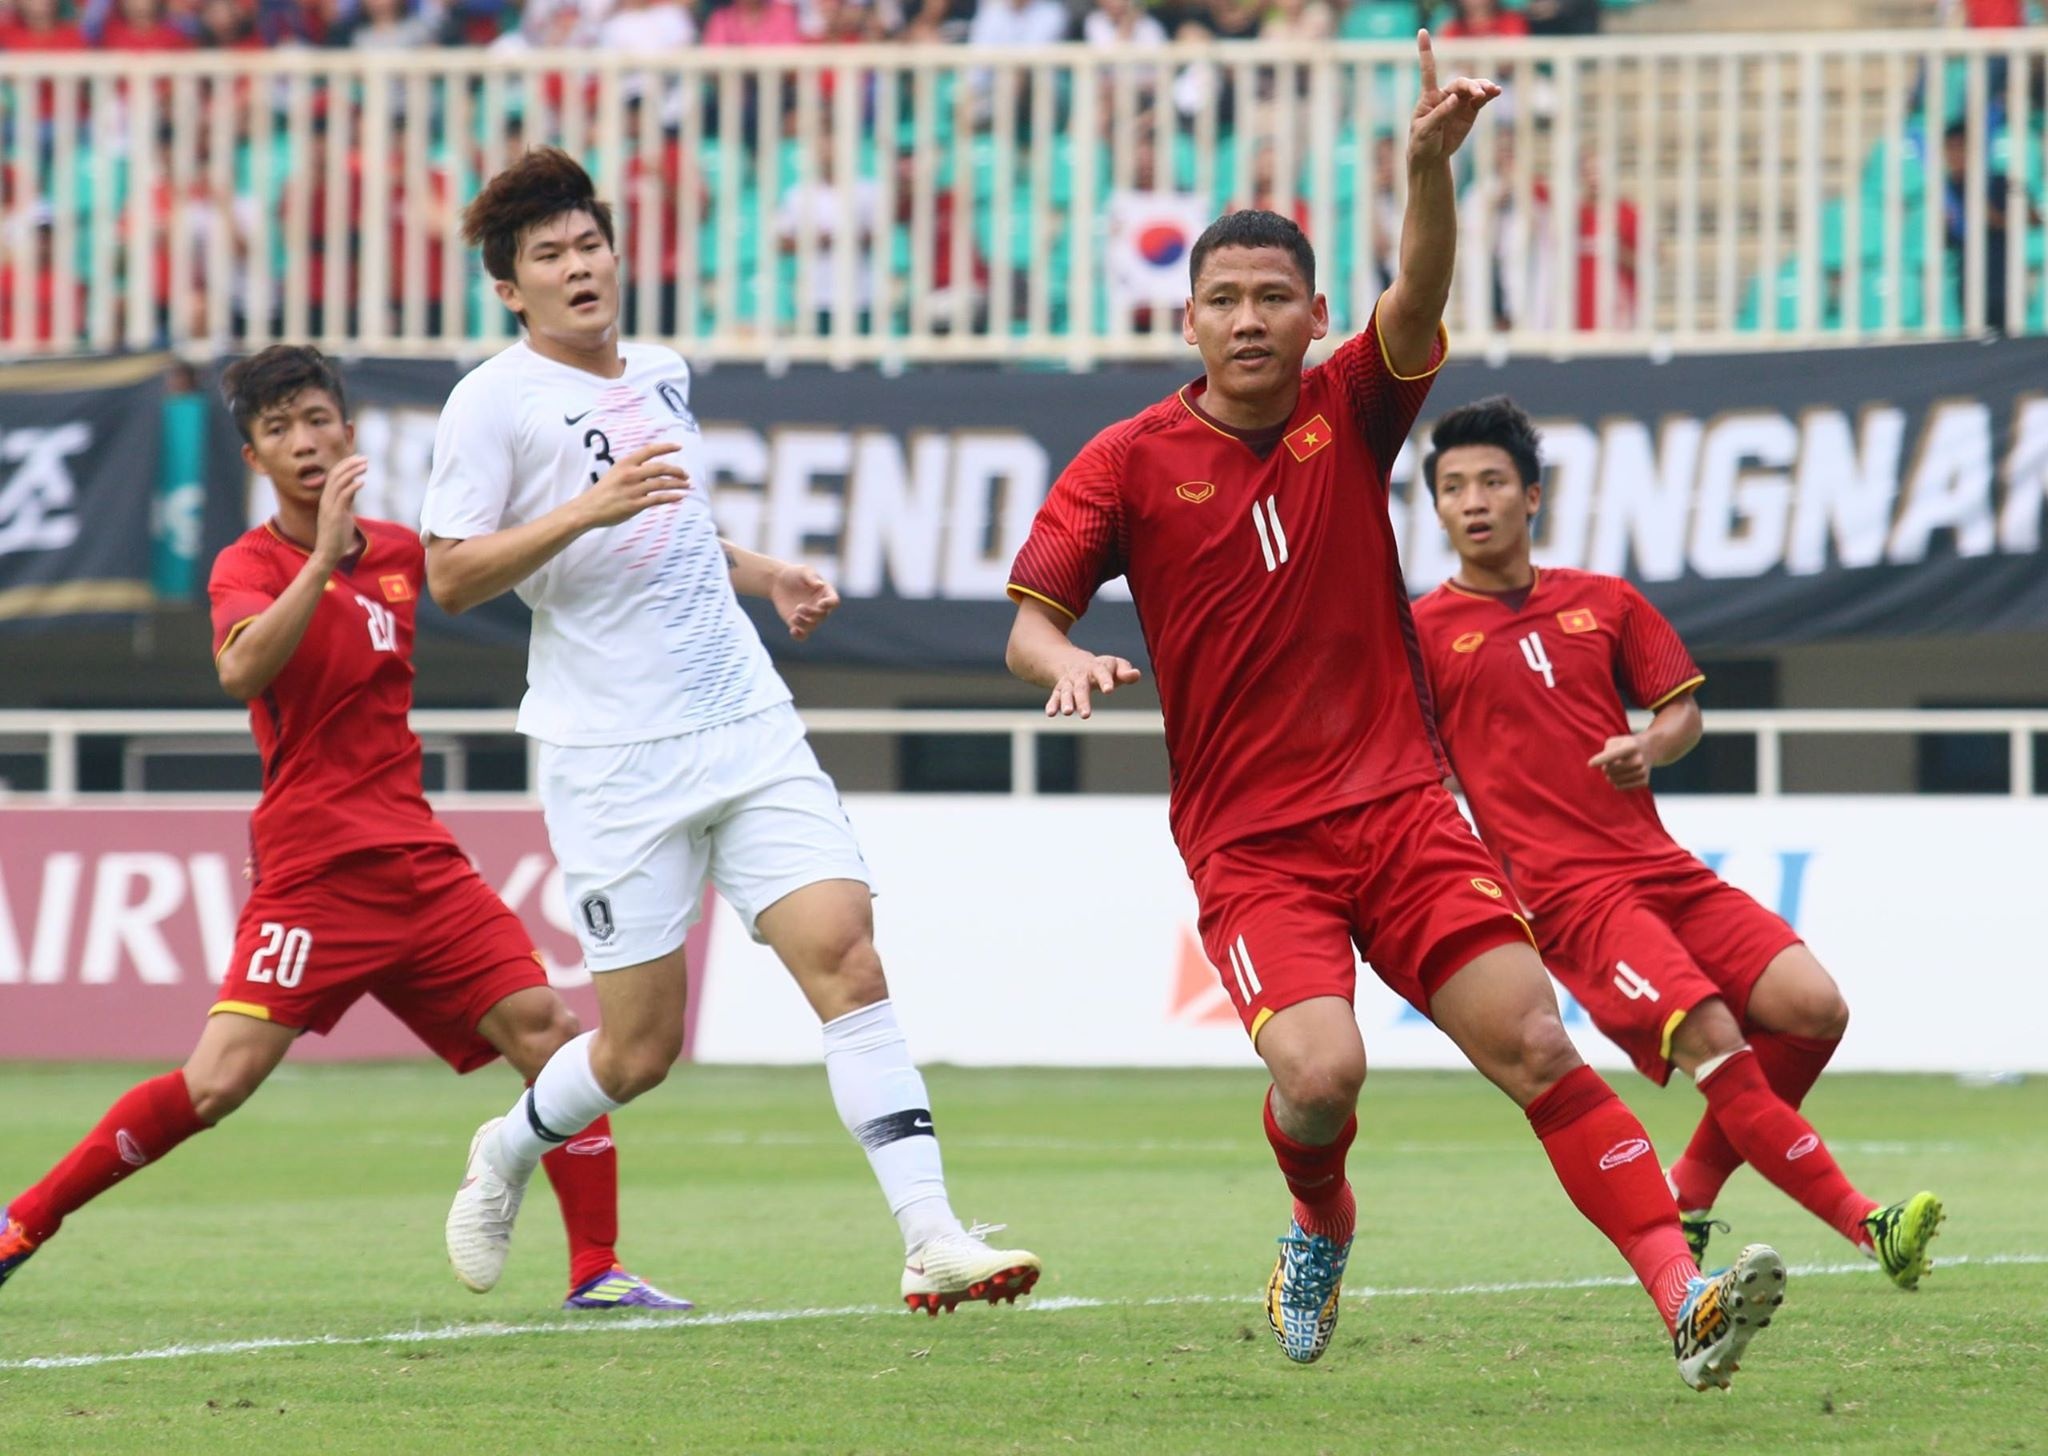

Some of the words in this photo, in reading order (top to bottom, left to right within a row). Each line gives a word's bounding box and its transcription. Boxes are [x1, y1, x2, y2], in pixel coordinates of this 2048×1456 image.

[584, 429, 615, 485] 3
[697, 424, 1050, 600] GEND
[1389, 393, 2048, 592] ONGNA
[1252, 494, 1289, 572] 11
[1518, 631, 1555, 688] 4
[246, 921, 313, 988] 20
[1229, 933, 1262, 1006] 11
[1613, 960, 1660, 1002] 4
